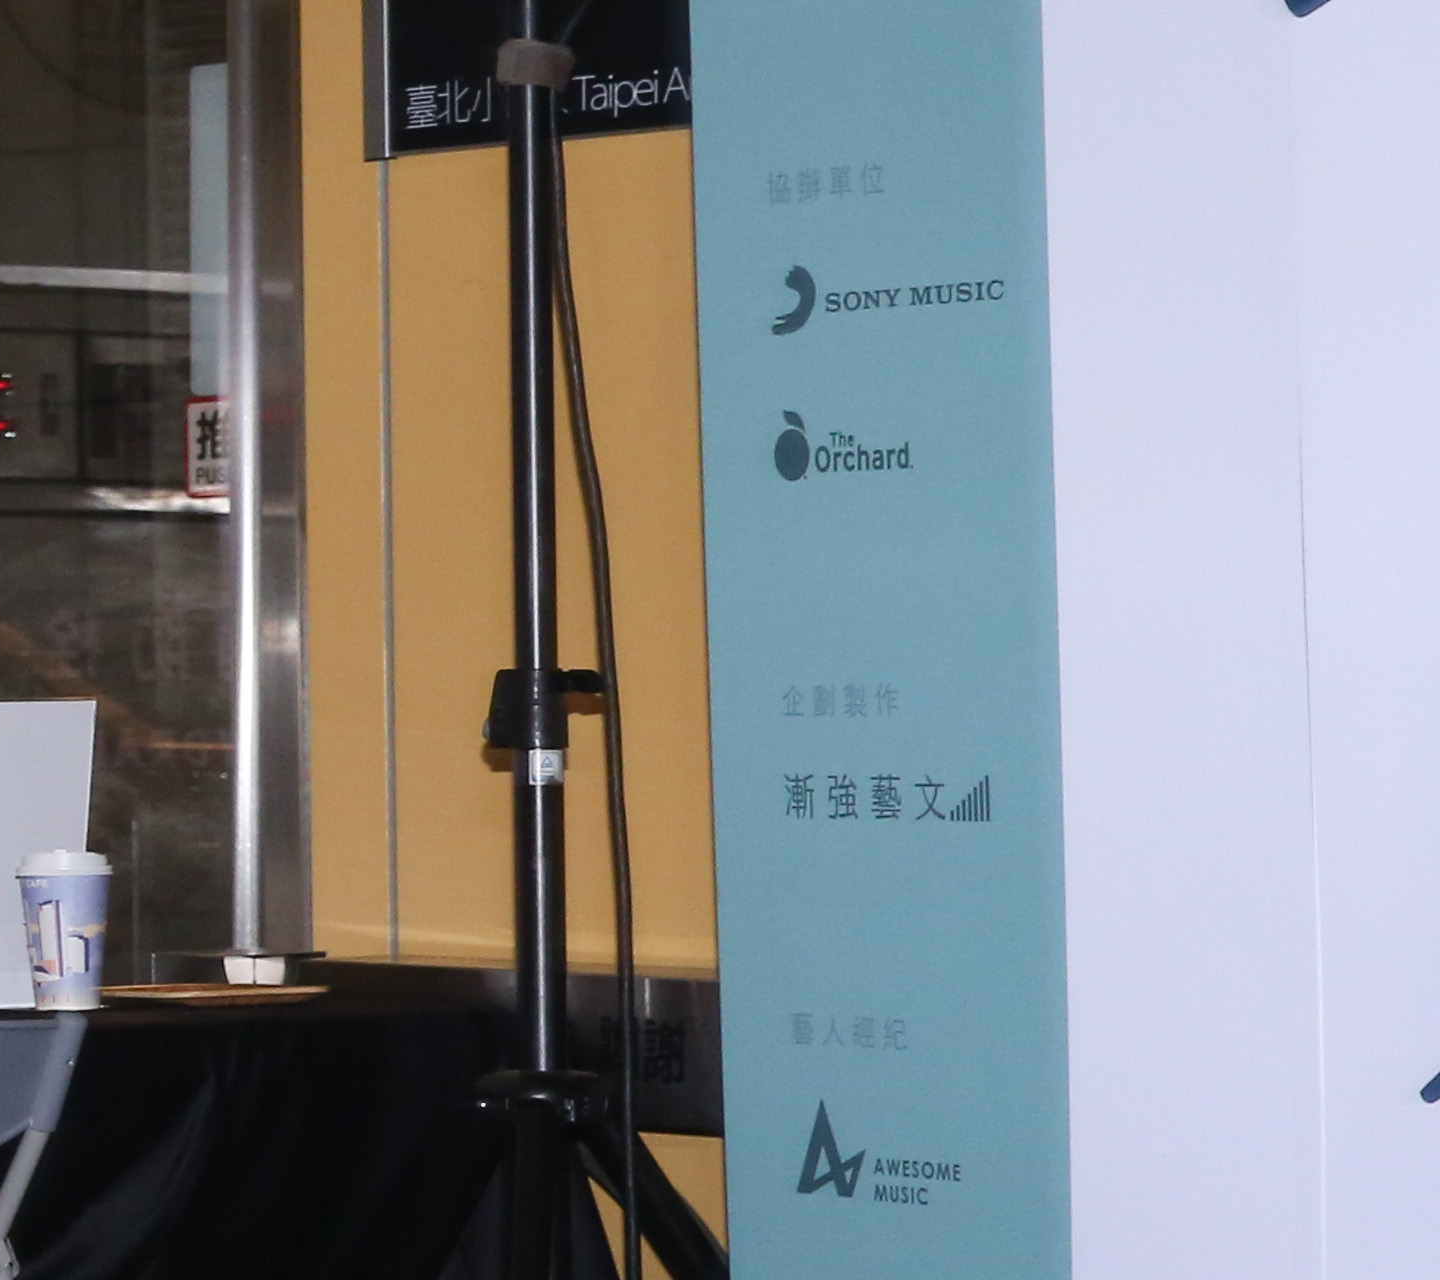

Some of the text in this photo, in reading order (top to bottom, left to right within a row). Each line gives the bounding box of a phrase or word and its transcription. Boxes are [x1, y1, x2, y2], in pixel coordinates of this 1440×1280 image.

[572, 69, 659, 119] Taipei
[825, 279, 1006, 312] SONY MUSIC
[829, 431, 855, 448] The
[814, 441, 910, 474] Orchard
[195, 467, 225, 485] PUS
[783, 773, 947, 821] 漸強藝文
[873, 1157, 962, 1183] AWESOME
[872, 1181, 929, 1206] MUSIC
